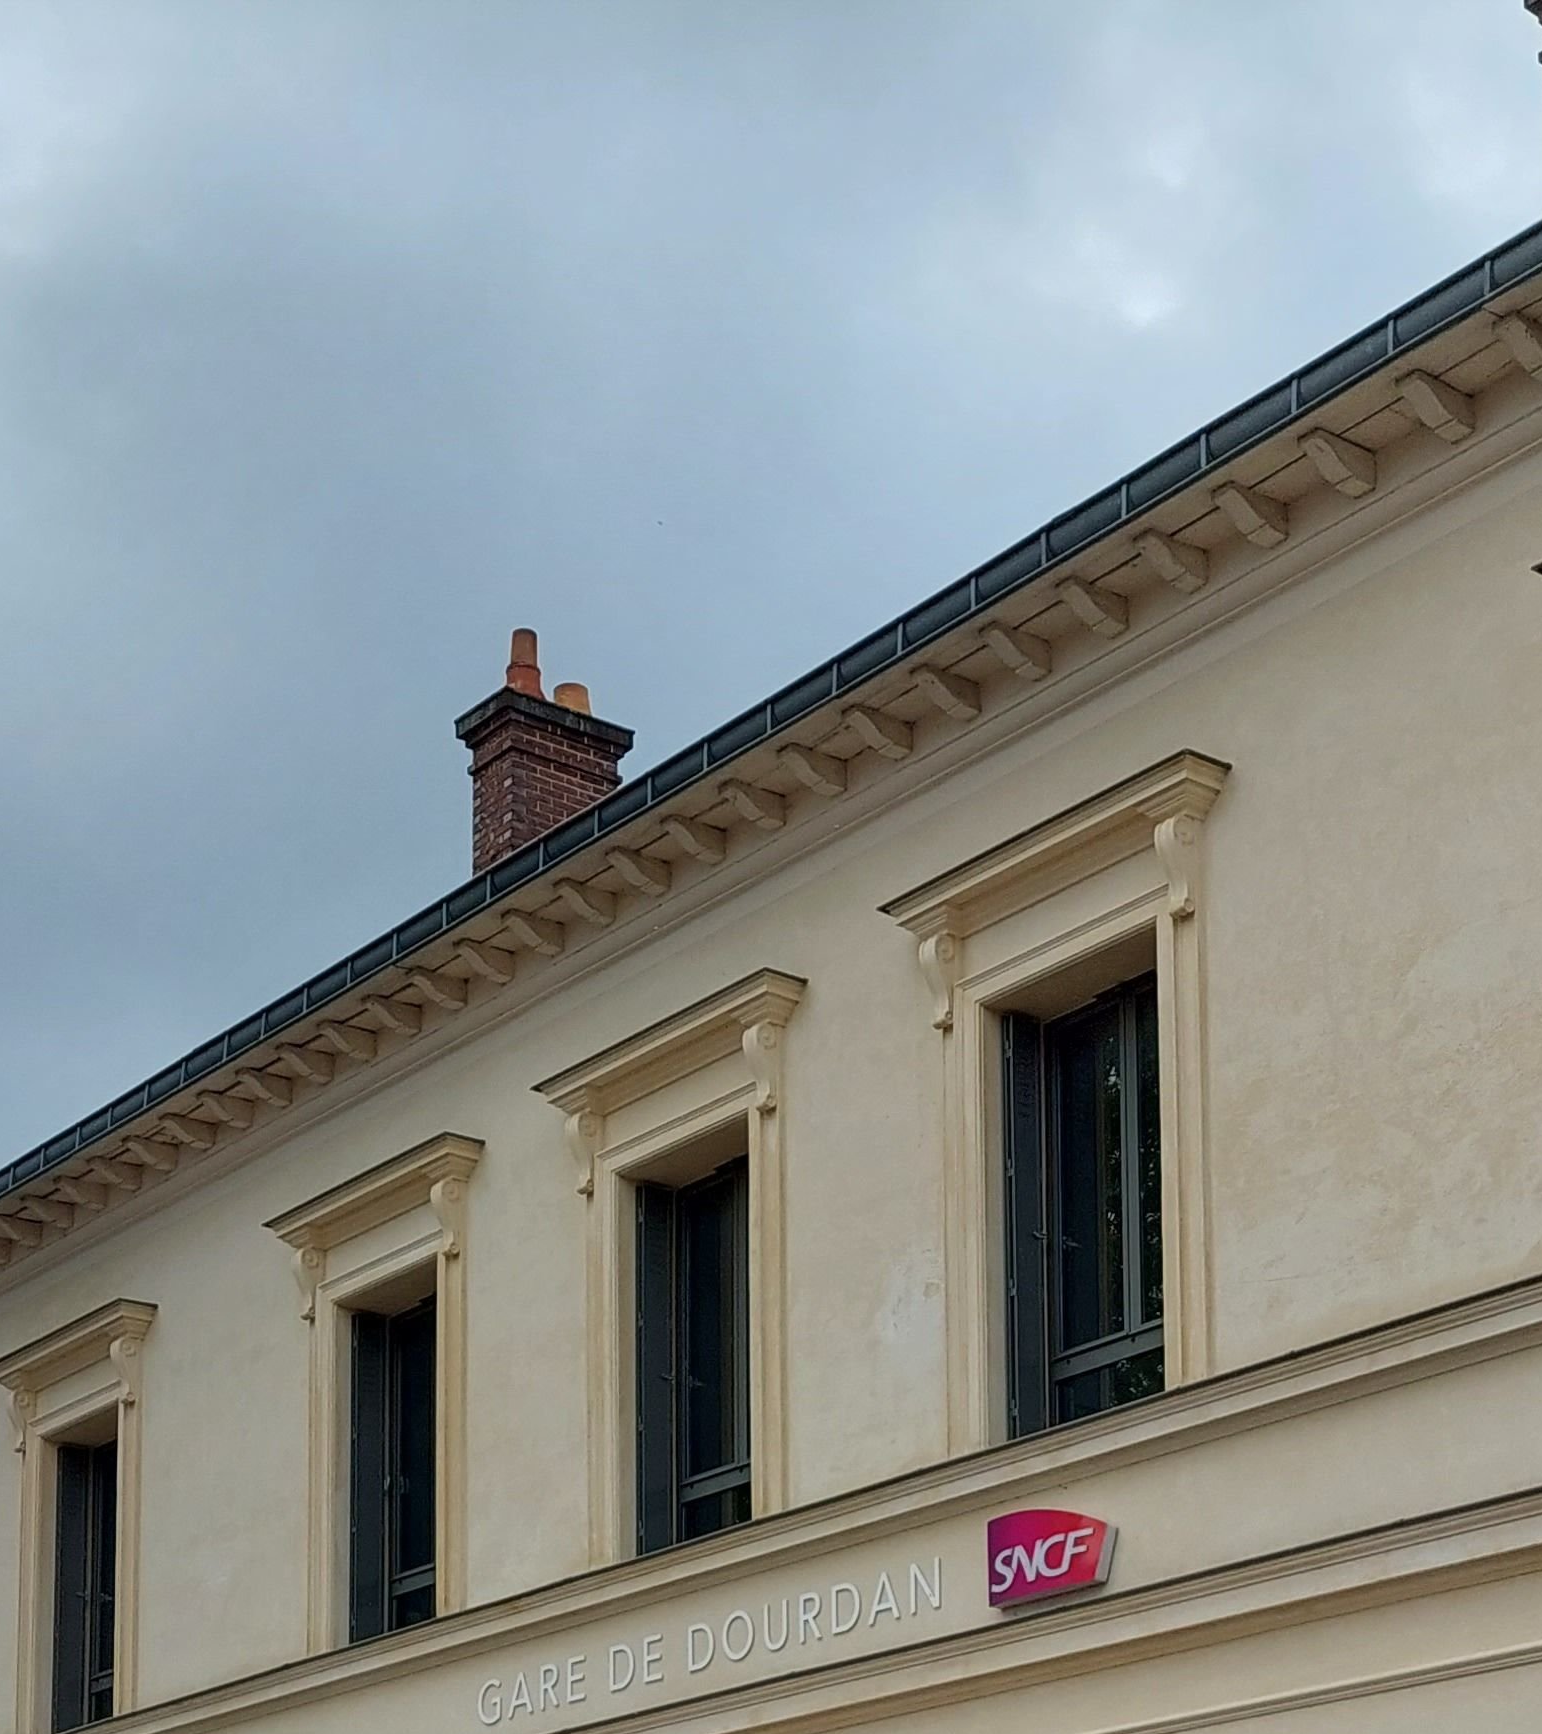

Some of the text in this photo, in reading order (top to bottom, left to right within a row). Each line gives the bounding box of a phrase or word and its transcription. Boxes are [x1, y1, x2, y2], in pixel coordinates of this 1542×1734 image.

[991, 1527, 1094, 1593] SNCF
[477, 1556, 943, 1725] GARE DE DOURDAN
